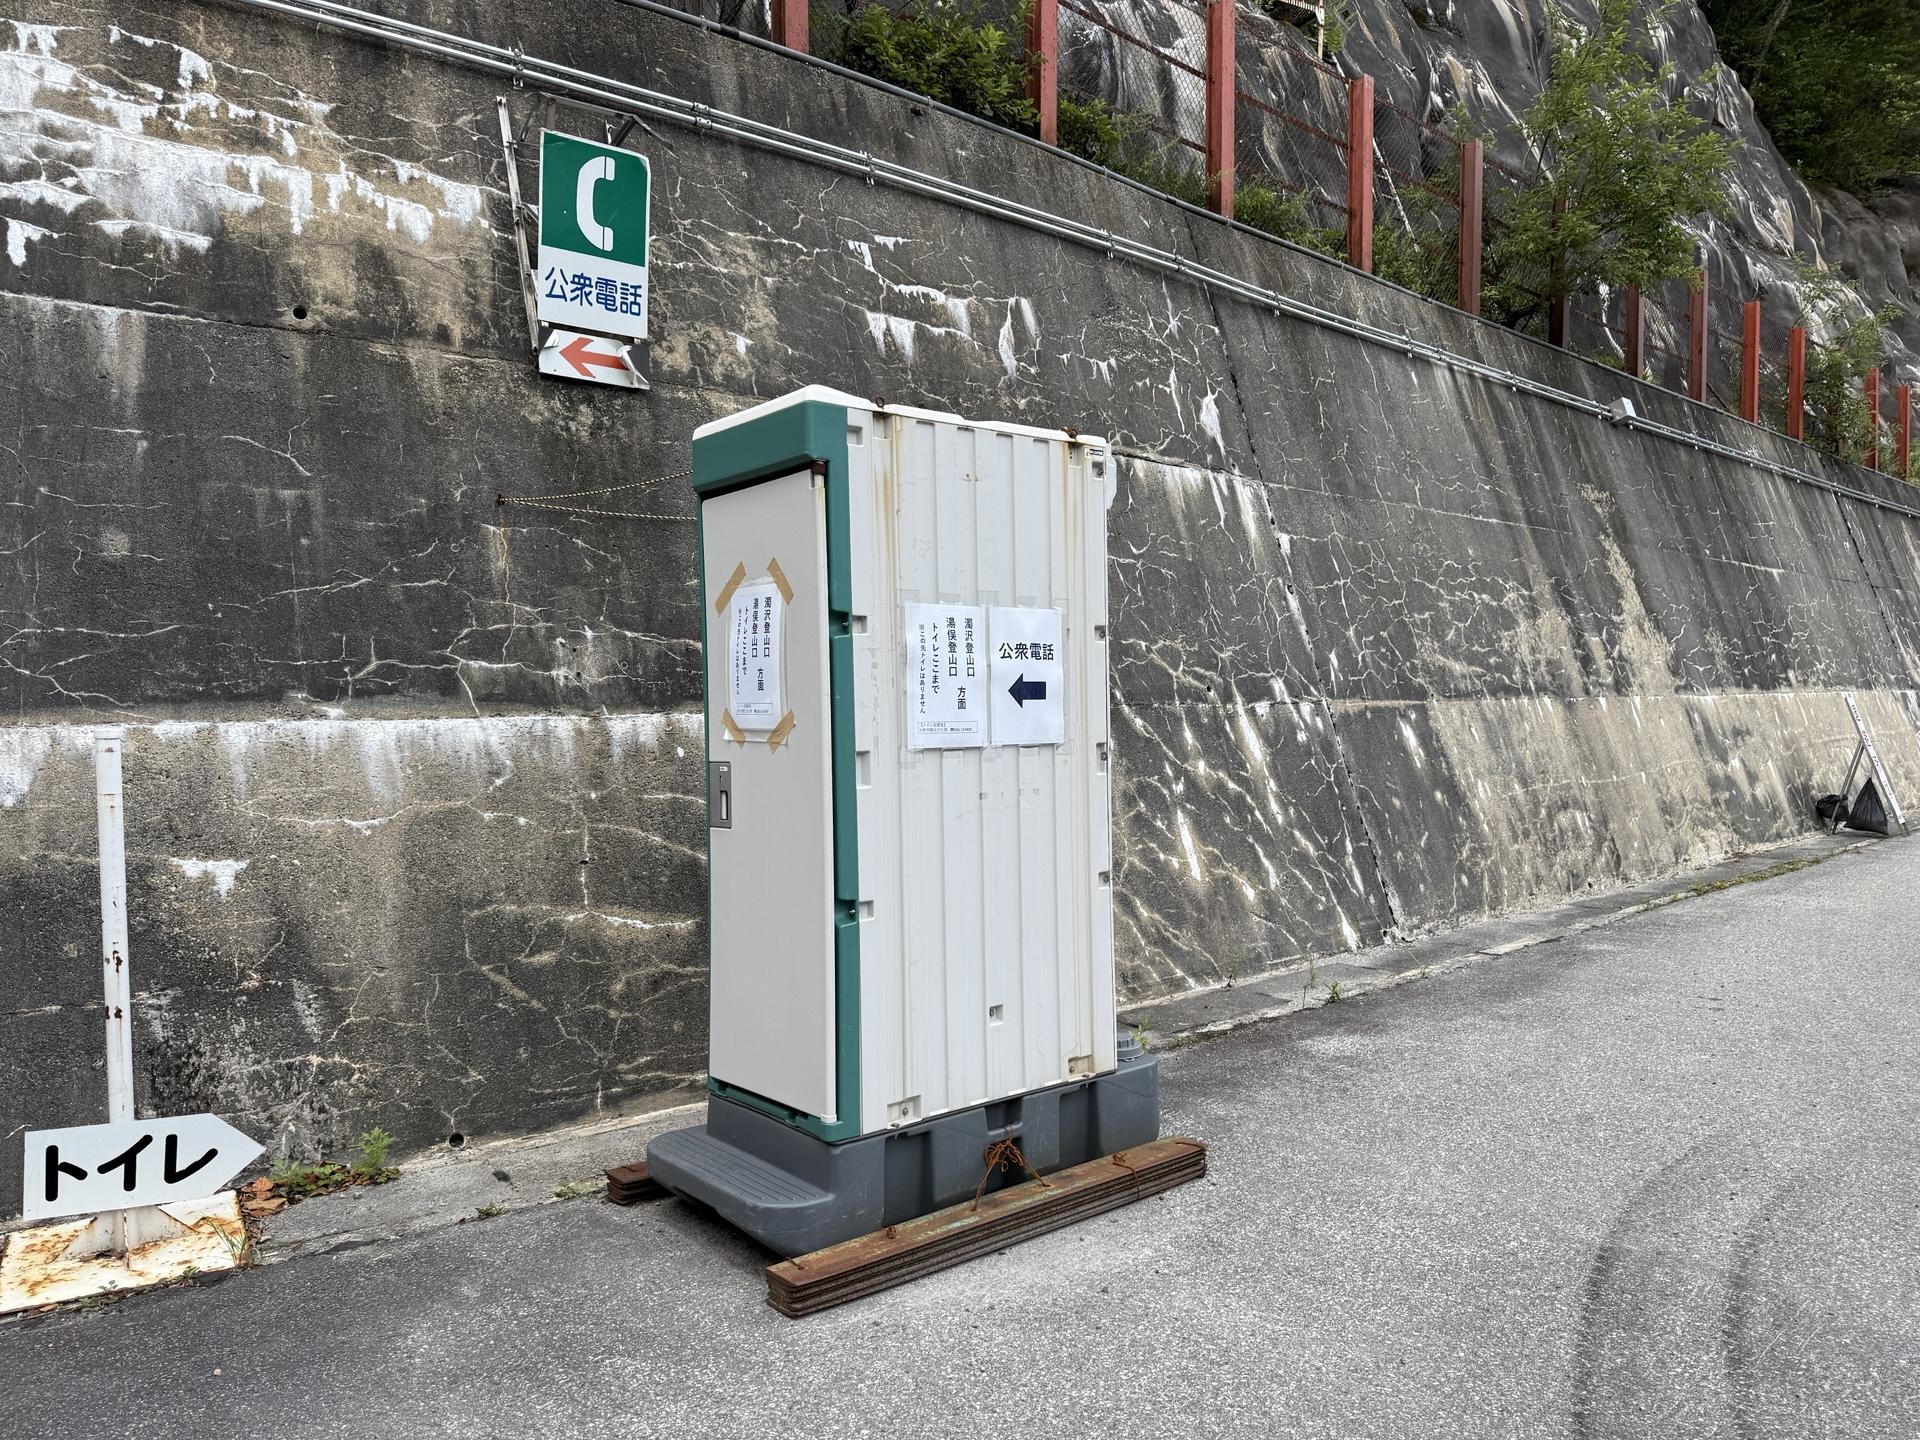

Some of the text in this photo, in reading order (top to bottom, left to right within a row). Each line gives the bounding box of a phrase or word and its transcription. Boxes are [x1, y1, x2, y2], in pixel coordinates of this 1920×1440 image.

[545, 267, 642, 316] 公衆電話
[741, 606, 749, 676] トイレここまで
[931, 622, 940, 694] トイレここまで
[946, 617, 958, 678] 湯俣登山口
[964, 617, 975, 678] 濁沢登山口
[998, 642, 1054, 661] 公衆電話
[757, 668, 765, 691] 方面
[957, 685, 967, 710] 方面
[45, 1134, 218, 1202] トイレ
